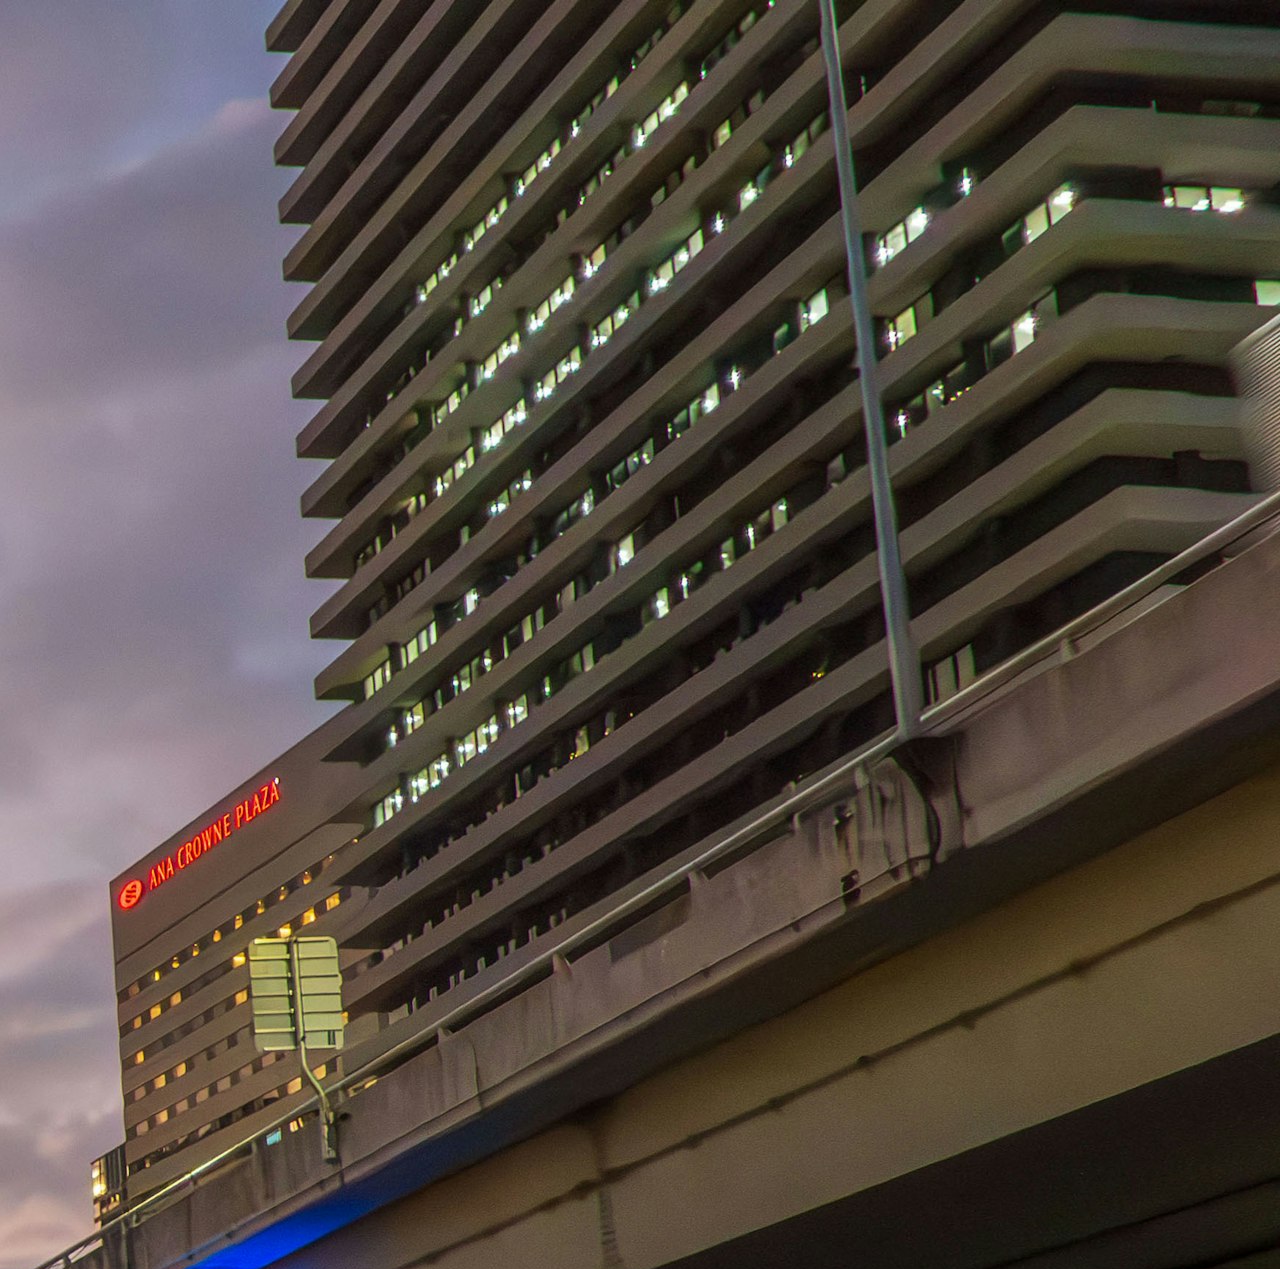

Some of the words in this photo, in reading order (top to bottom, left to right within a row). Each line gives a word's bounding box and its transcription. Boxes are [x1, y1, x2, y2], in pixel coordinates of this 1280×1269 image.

[149, 856, 174, 890] ANA
[177, 813, 232, 870] CROWNE
[235, 779, 280, 829] PLAZA
